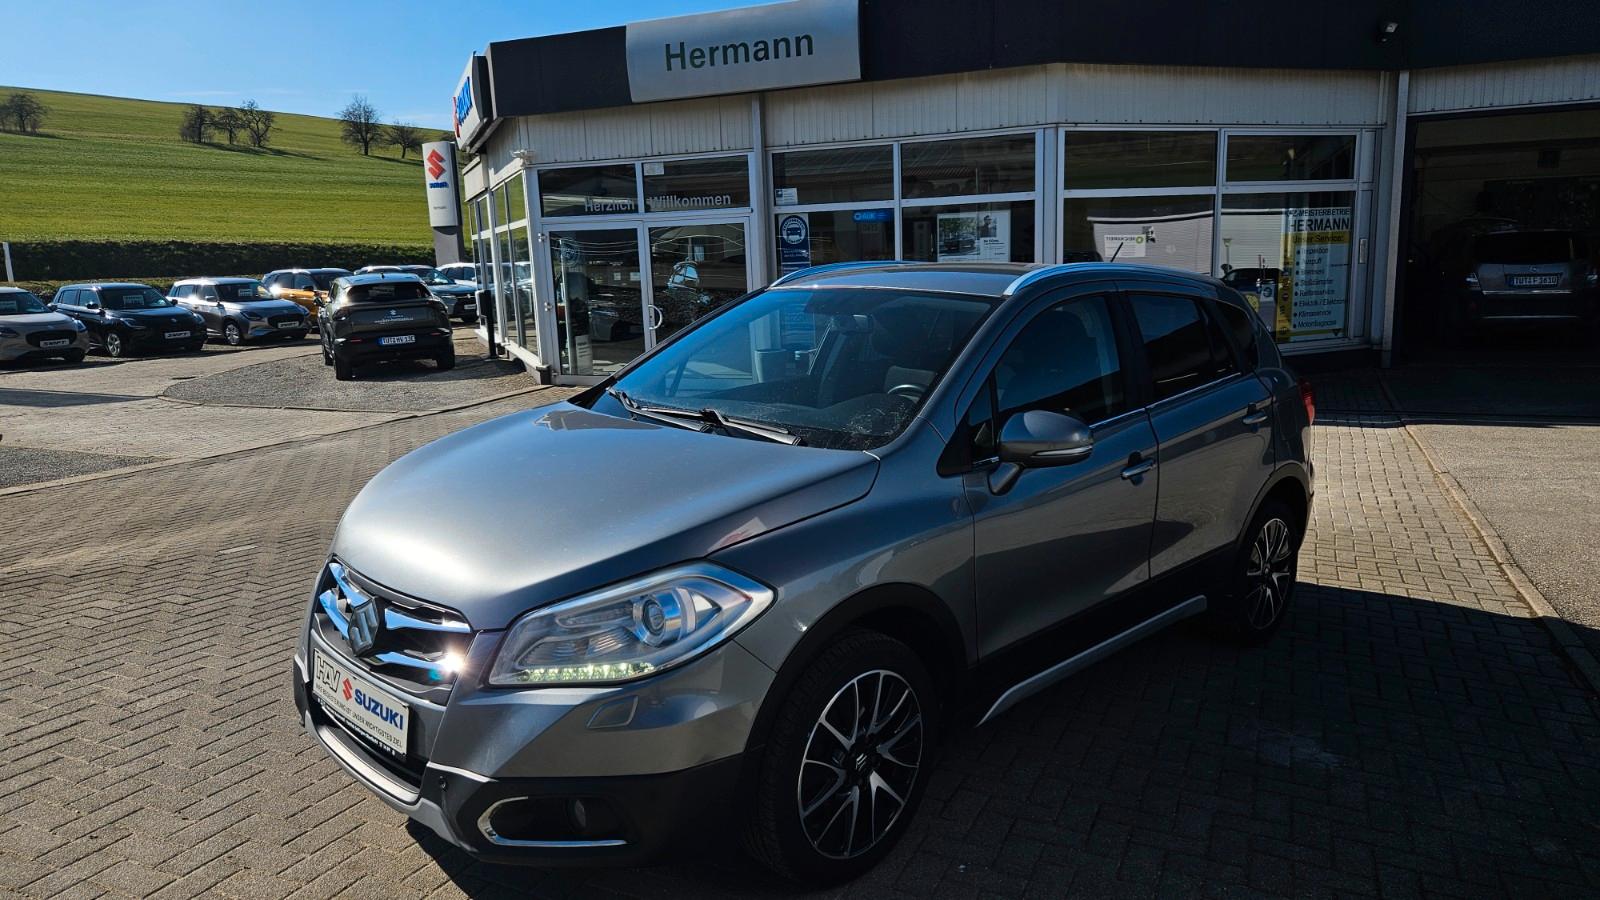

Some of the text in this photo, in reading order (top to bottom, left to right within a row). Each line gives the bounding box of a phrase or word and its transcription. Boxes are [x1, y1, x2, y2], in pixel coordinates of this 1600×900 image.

[665, 34, 814, 71] Hermann
[584, 194, 731, 212] Herzlich Willkommen
[1290, 217, 1350, 232] HERMANN
[354, 688, 404, 731] SUZUKI
